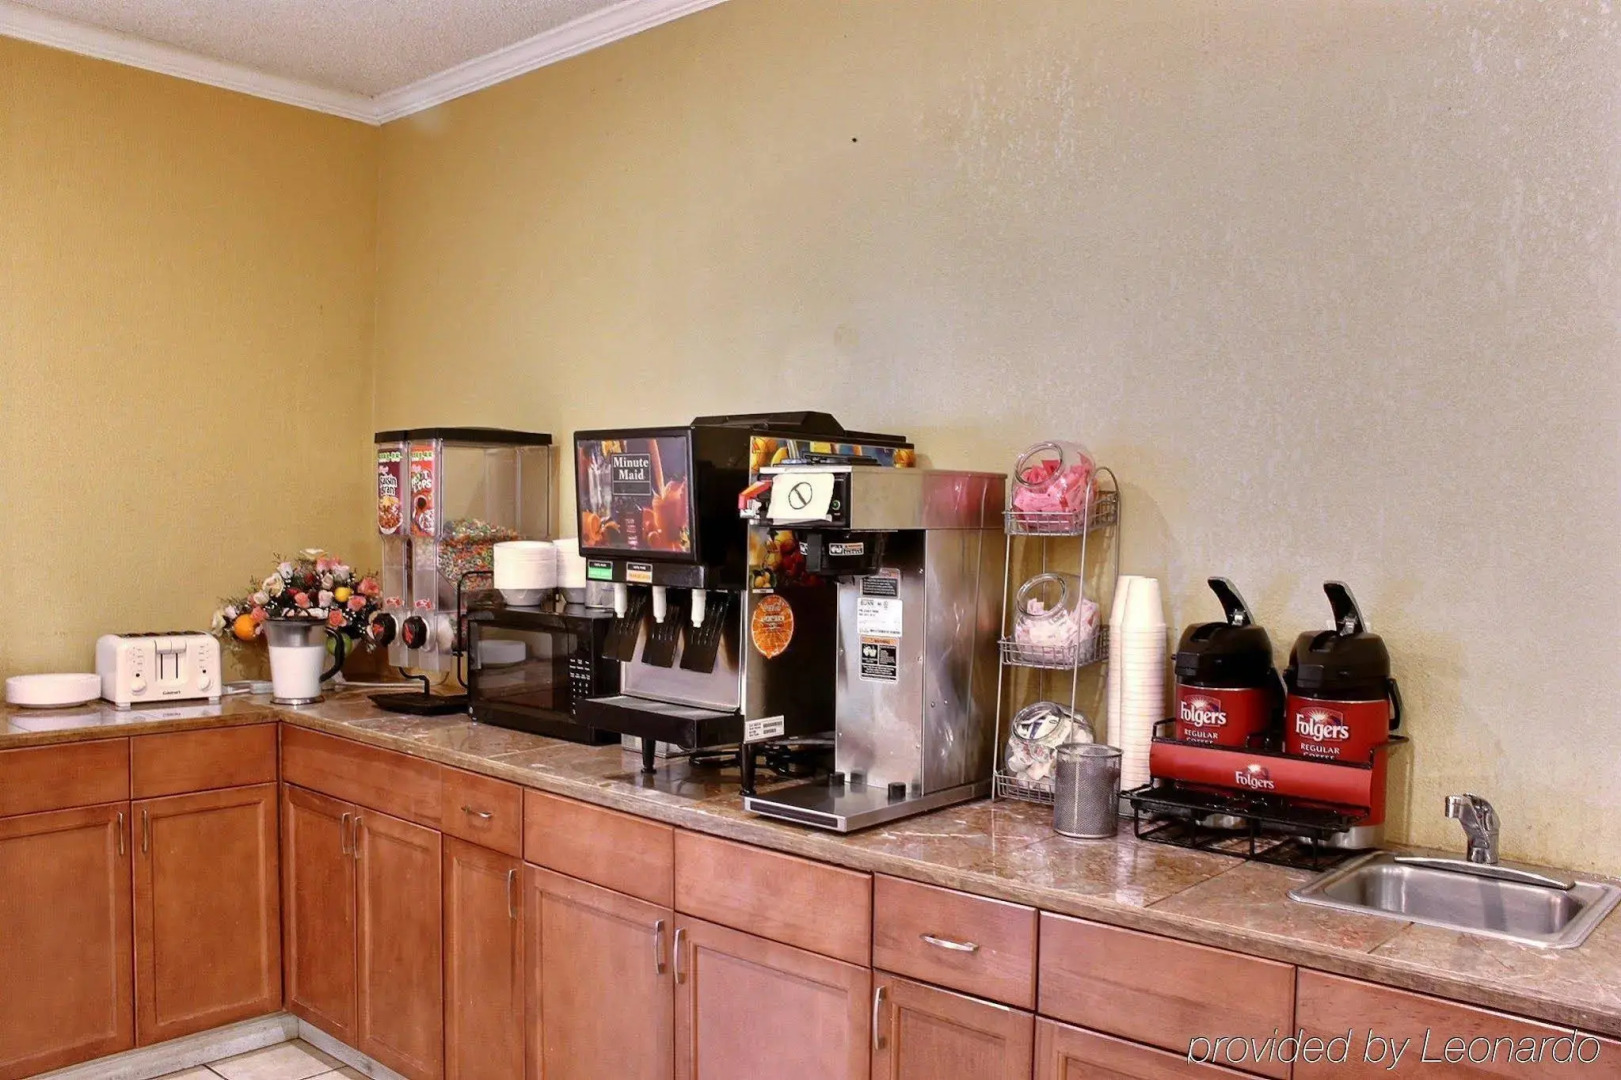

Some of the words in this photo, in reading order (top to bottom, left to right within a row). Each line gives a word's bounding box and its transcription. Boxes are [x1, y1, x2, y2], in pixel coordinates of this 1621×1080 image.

[613, 456, 649, 468] Minute
[619, 469, 644, 480] Maid
[1180, 700, 1227, 727] Folgers
[1295, 712, 1350, 742] Folgers
[1184, 728, 1219, 739] REGULAR
[1300, 742, 1340, 754] REGULAR
[1235, 770, 1275, 789] Folgers
